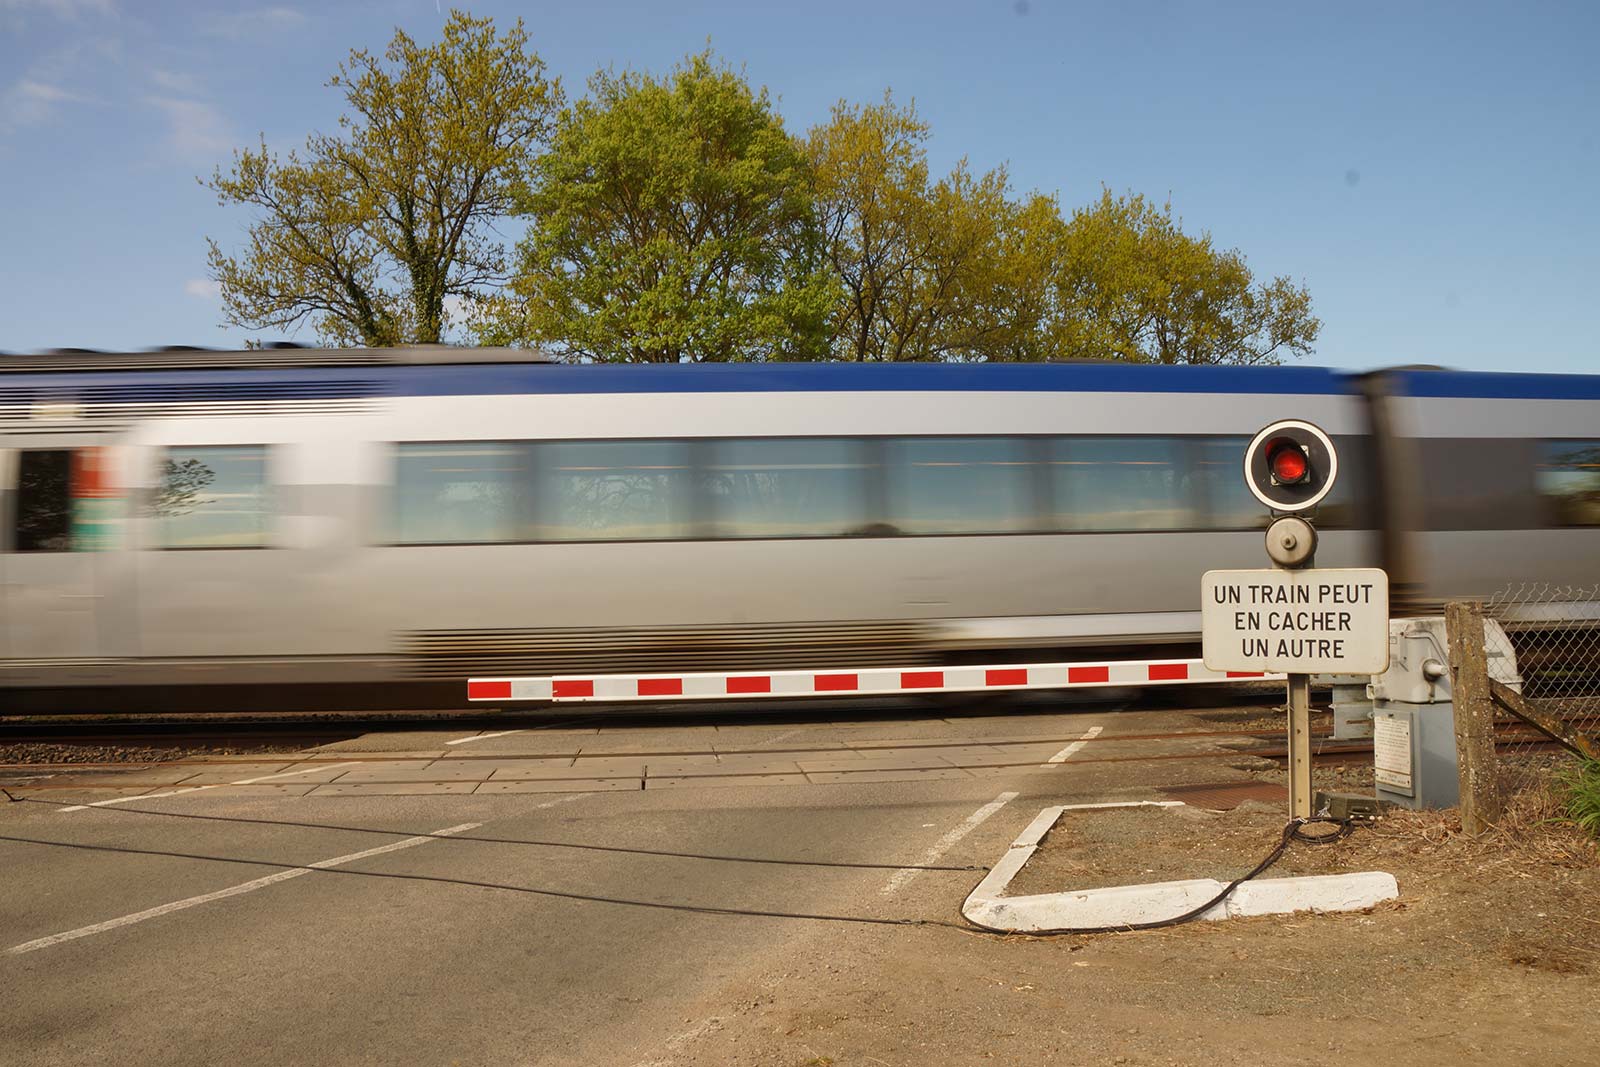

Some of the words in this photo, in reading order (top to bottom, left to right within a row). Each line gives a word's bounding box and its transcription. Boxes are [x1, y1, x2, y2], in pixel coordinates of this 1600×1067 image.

[1214, 585, 1241, 604] UN
[1248, 585, 1310, 604] TRAIN
[1319, 584, 1373, 604] PEUT
[1235, 612, 1260, 630] EN
[1268, 612, 1351, 631] CACHER
[1242, 639, 1269, 657] UN
[1276, 639, 1345, 658] AUTRE
